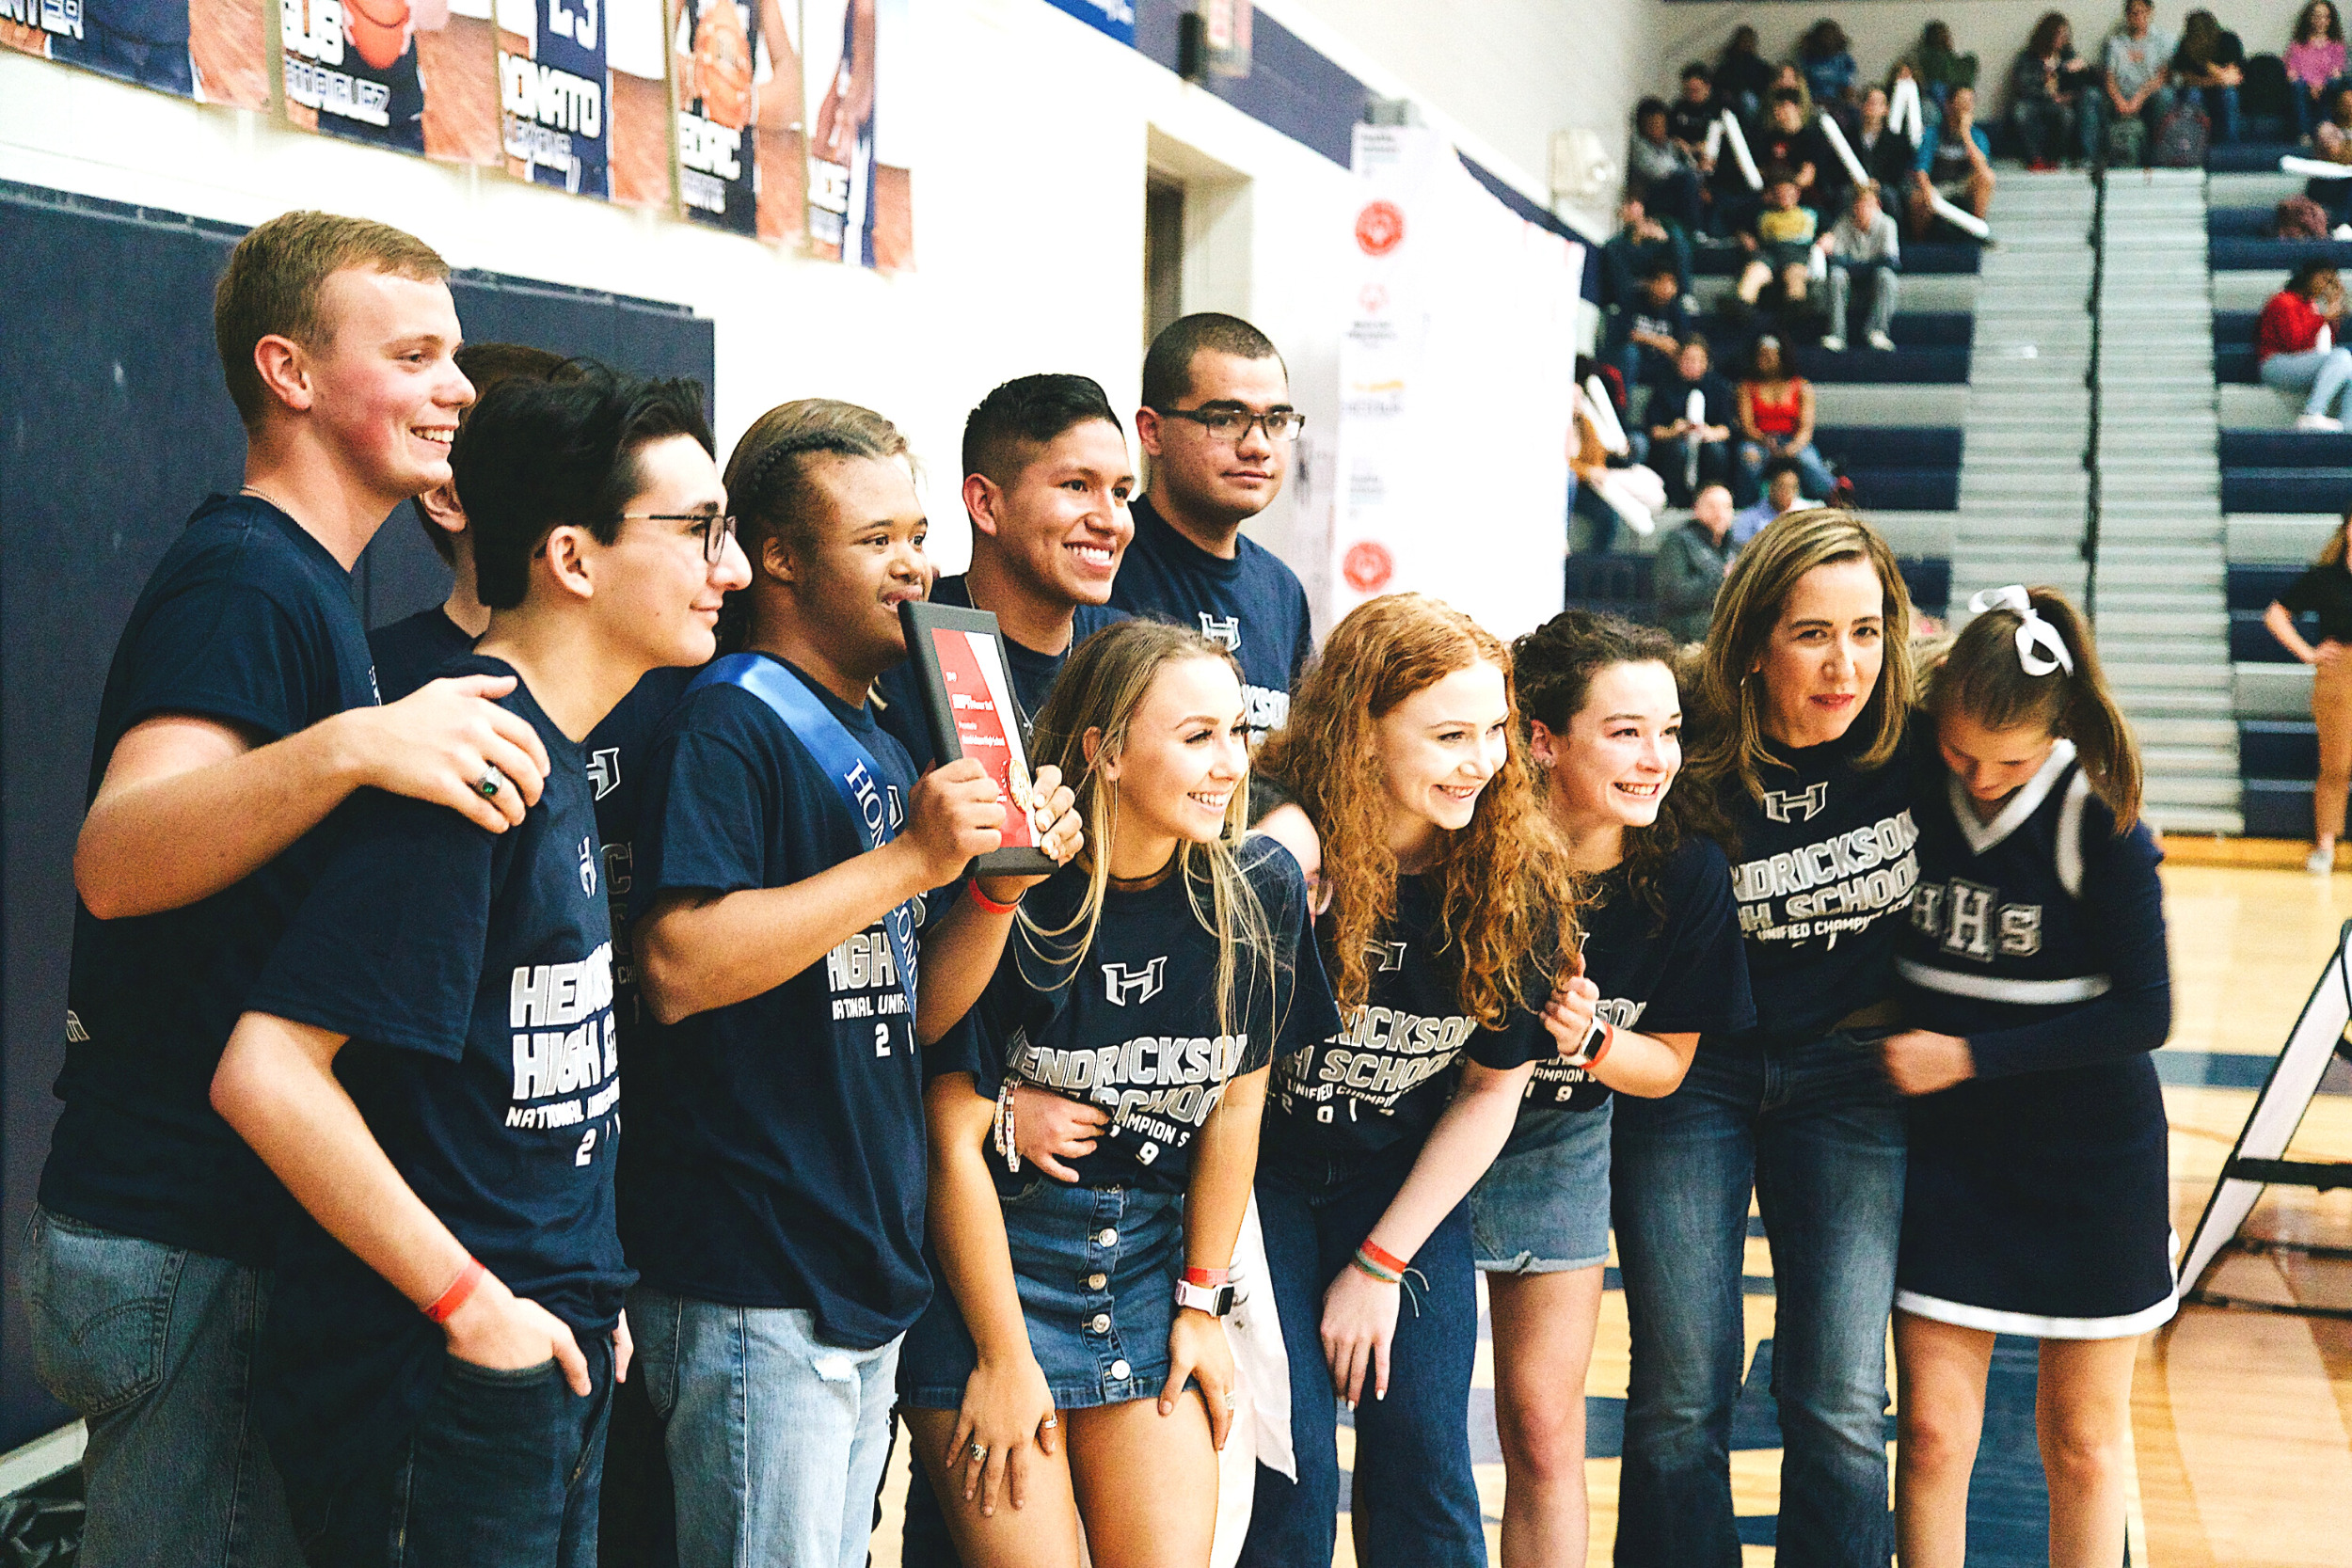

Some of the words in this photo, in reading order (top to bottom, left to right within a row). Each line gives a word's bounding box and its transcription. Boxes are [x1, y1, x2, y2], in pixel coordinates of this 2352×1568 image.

[1102, 956, 1168, 1006] H
[875, 1022, 891, 1058] 2
[1554, 1085, 1573, 1102] 9
[575, 1128, 596, 1166] 2
